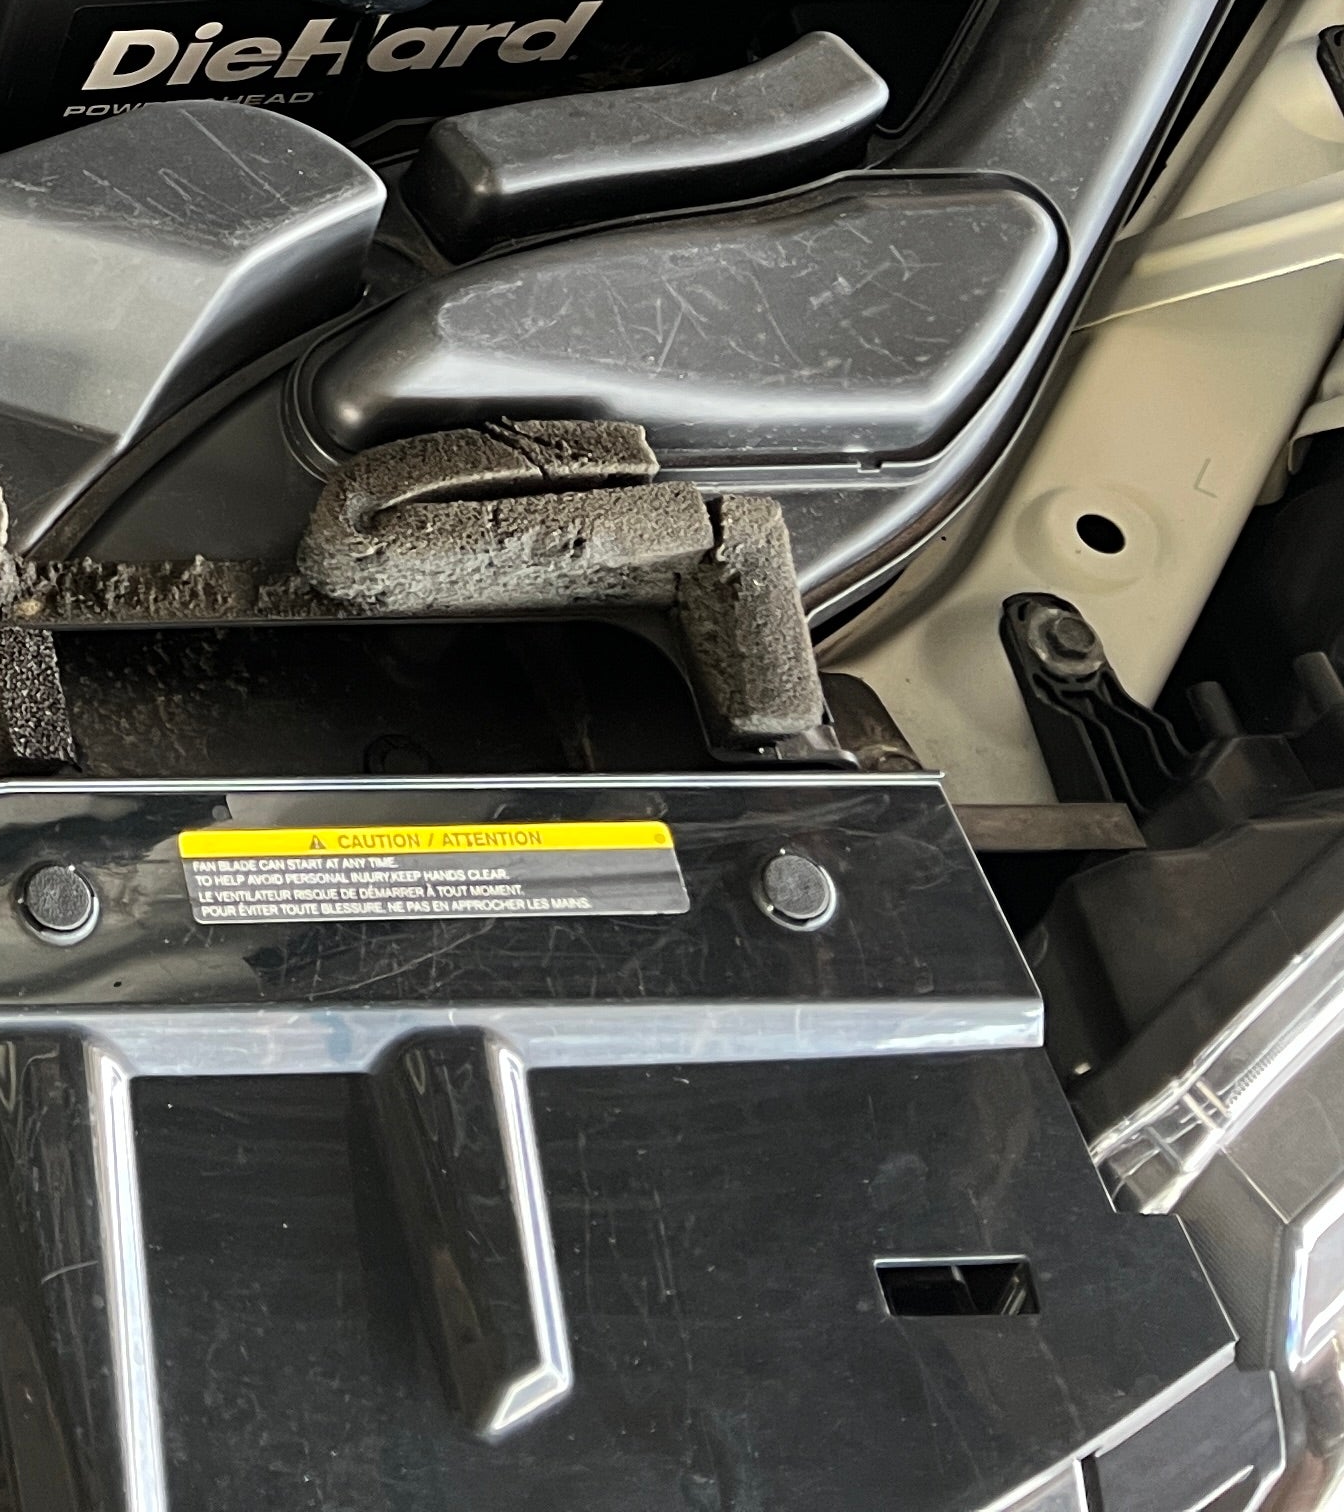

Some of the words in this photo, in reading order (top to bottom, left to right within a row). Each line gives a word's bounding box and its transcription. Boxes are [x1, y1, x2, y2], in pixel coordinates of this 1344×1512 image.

[80, 0, 604, 90] DieHard
[337, 832, 421, 850] CAUTION
[428, 831, 434, 847] /
[442, 830, 543, 848] ATTENTION
[193, 860, 216, 873] FAN
[218, 859, 256, 872] BLADE
[259, 859, 285, 871] CAN
[287, 858, 323, 870] START
[326, 858, 341, 869] AT
[342, 857, 367, 869] ANY
[194, 874, 212, 887] TO
[214, 873, 246, 886] HELP
[247, 873, 284, 885] AVOID
[285, 871, 349, 884] PERSONAL
[423, 869, 465, 882] HANDS
[467, 868, 510, 881] CLEAR.
[198, 891, 213, 903] LE
[217, 889, 292, 902] VENTILATEUR
[294, 888, 339, 902] RISQUE
[340, 888, 358, 900] DE
[358, 885, 425, 900] DÉMARRER
[437, 886, 468, 899] TOUT
[469, 884, 525, 897] MOMENT.
[202, 905, 237, 917] POUR
[238, 902, 278, 917] ÉVITER
[280, 903, 320, 916] TOUTE
[388, 901, 406, 914] NE
[406, 901, 430, 914] PAS
[432, 900, 450, 913] EN
[451, 898, 526, 912] APPROCHER
[526, 897, 551, 910] LES
